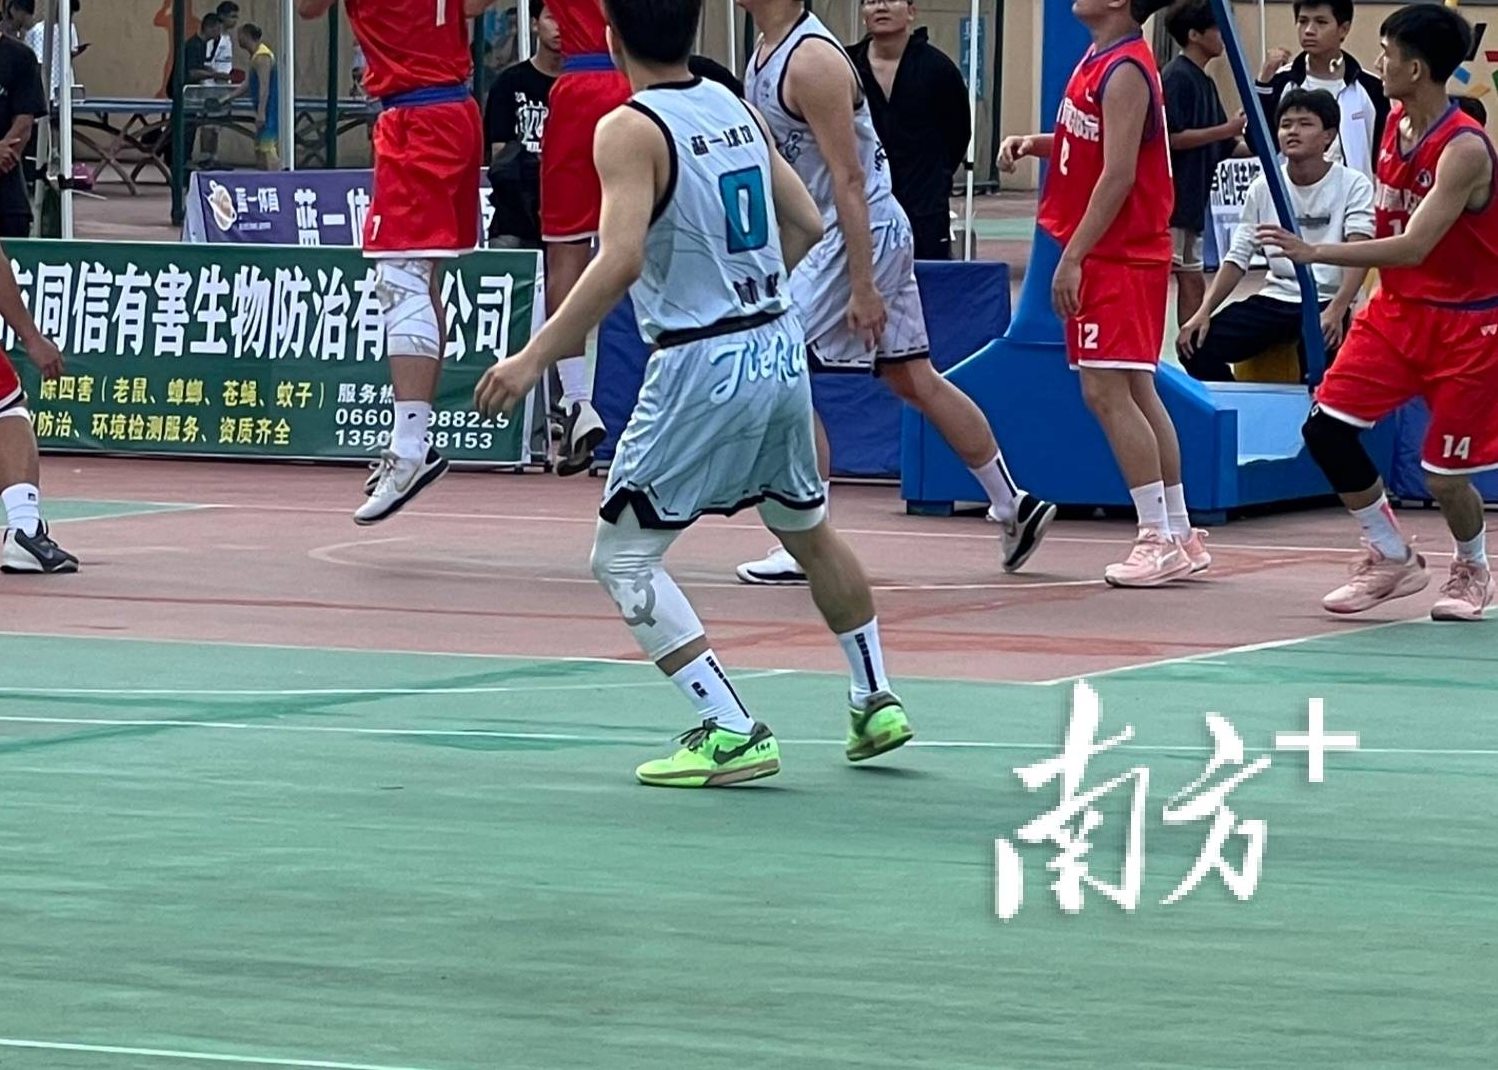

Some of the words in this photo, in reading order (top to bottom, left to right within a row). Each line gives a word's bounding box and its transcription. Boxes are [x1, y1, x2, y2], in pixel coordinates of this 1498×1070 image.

[718, 165, 768, 254] 0
[371, 215, 381, 241] 7
[1442, 434, 1471, 461] 14
